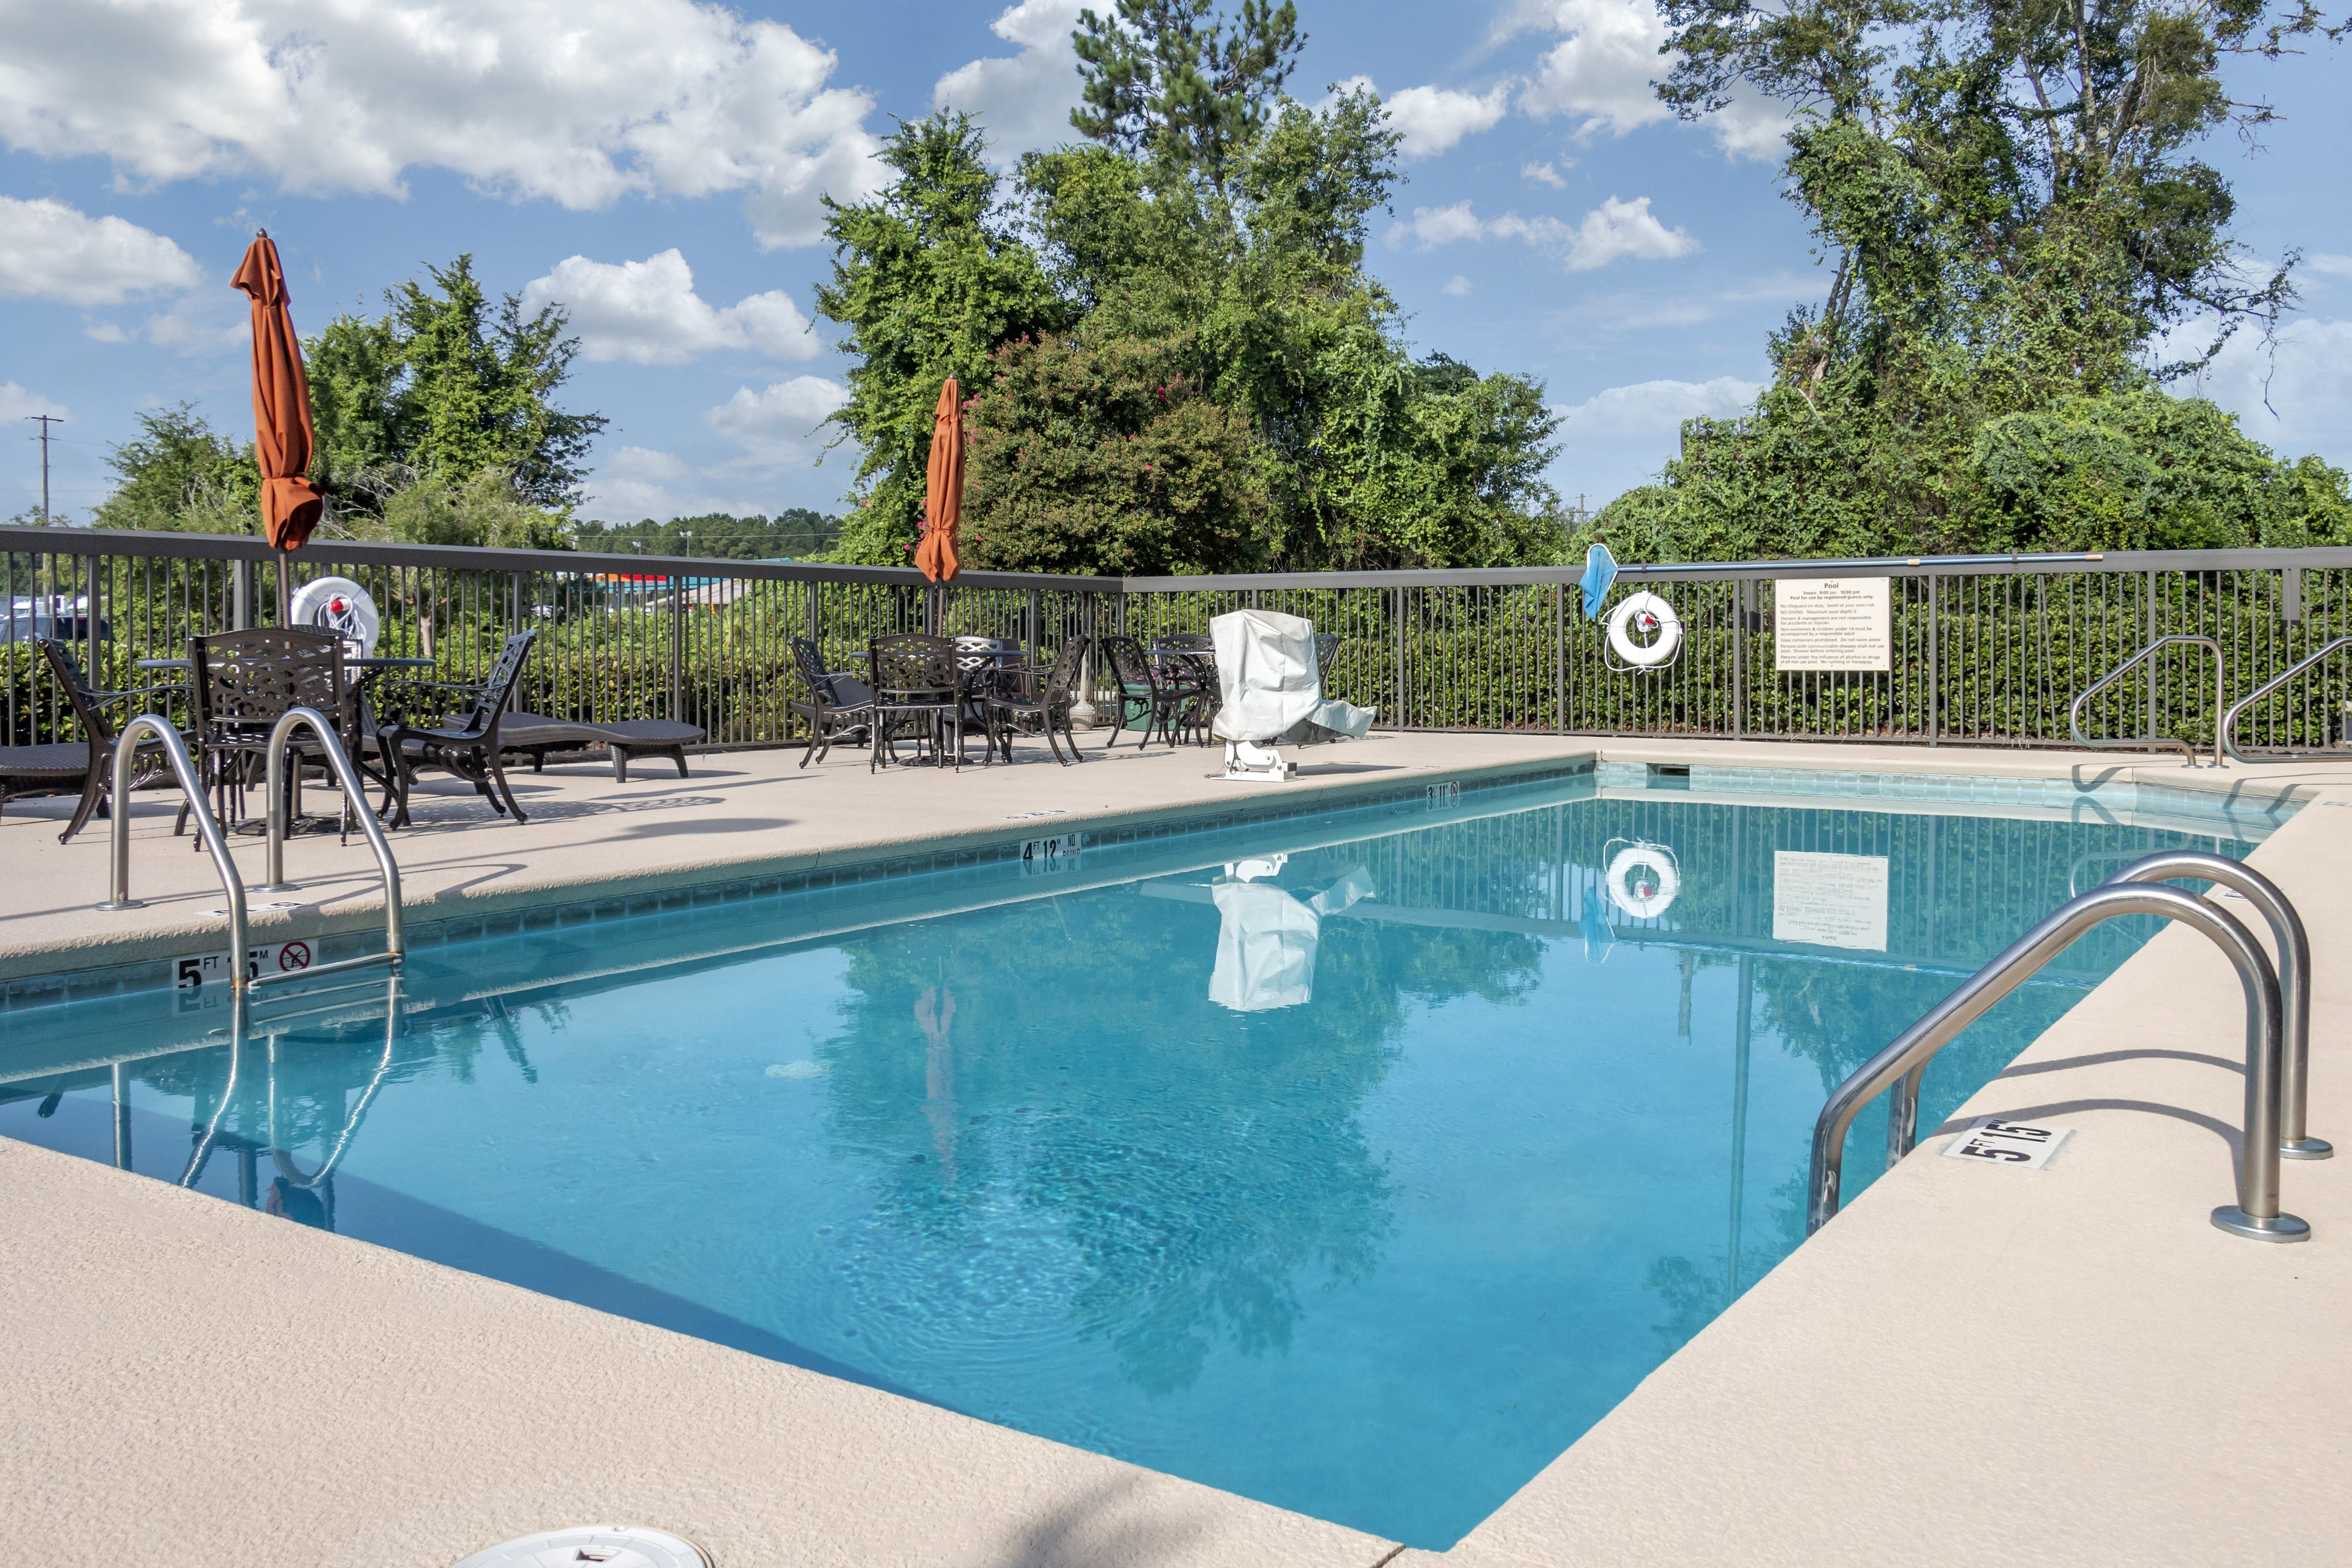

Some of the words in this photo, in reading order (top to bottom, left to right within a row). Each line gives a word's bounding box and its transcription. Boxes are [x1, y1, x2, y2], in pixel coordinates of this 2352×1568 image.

[1068, 834, 1075, 847] NO
[1023, 842, 1033, 860] 4
[1033, 841, 1040, 850] FT
[260, 950, 268, 960] M
[178, 959, 202, 989] 5
[204, 956, 219, 970] FT
[1969, 1139, 1996, 1148] FT
[1959, 1145, 2032, 1162] 5
